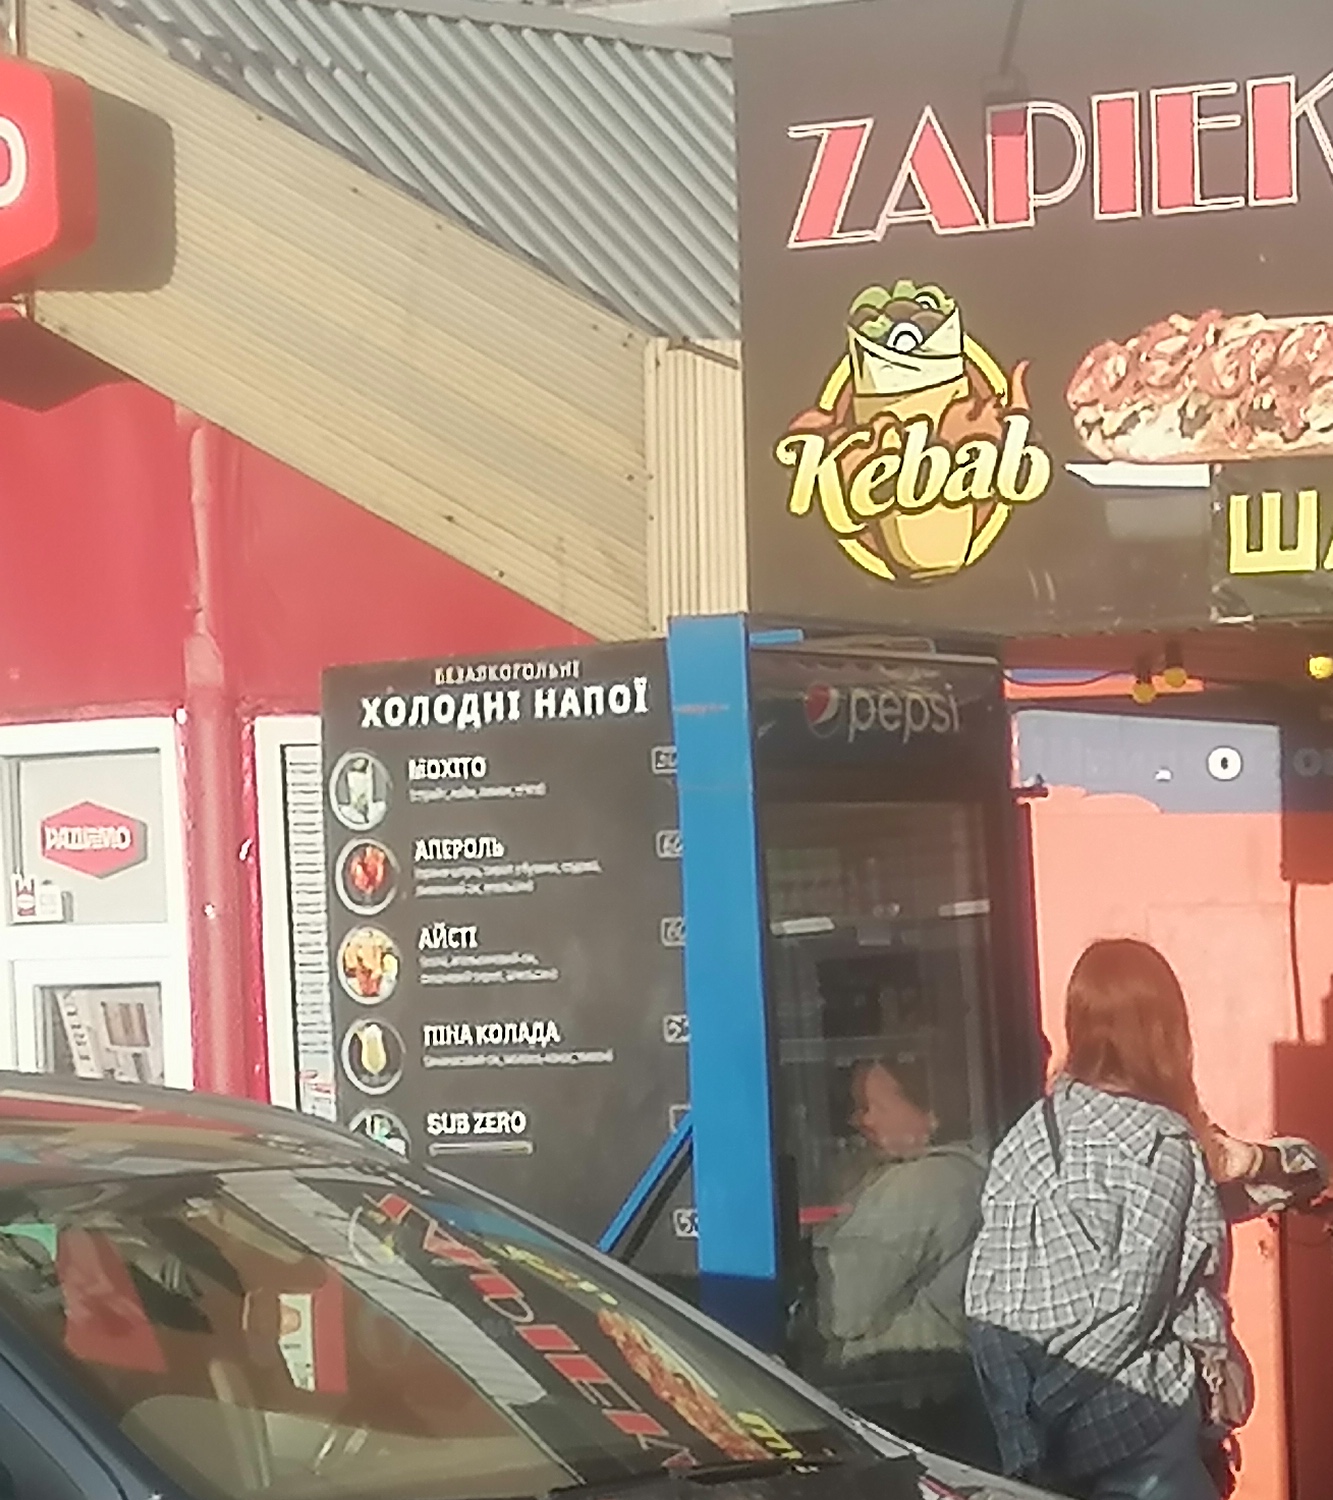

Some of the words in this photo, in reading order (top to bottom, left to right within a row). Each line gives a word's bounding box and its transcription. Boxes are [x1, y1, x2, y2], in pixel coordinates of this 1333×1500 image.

[775, 411, 1052, 534] Kebab
[361, 689, 520, 729] ХОЛОДНІ
[535, 677, 649, 718] НАПОЇ
[847, 683, 961, 745] pepsi
[408, 757, 488, 780] МОХІТО
[414, 837, 504, 861] АПЕРОЛЬ
[418, 922, 479, 949] АЙСТІ
[424, 1023, 473, 1047] ПІНА
[476, 1020, 560, 1047] КОЛАДА
[427, 1112, 470, 1135] SUB
[473, 1111, 526, 1133] ZERO
